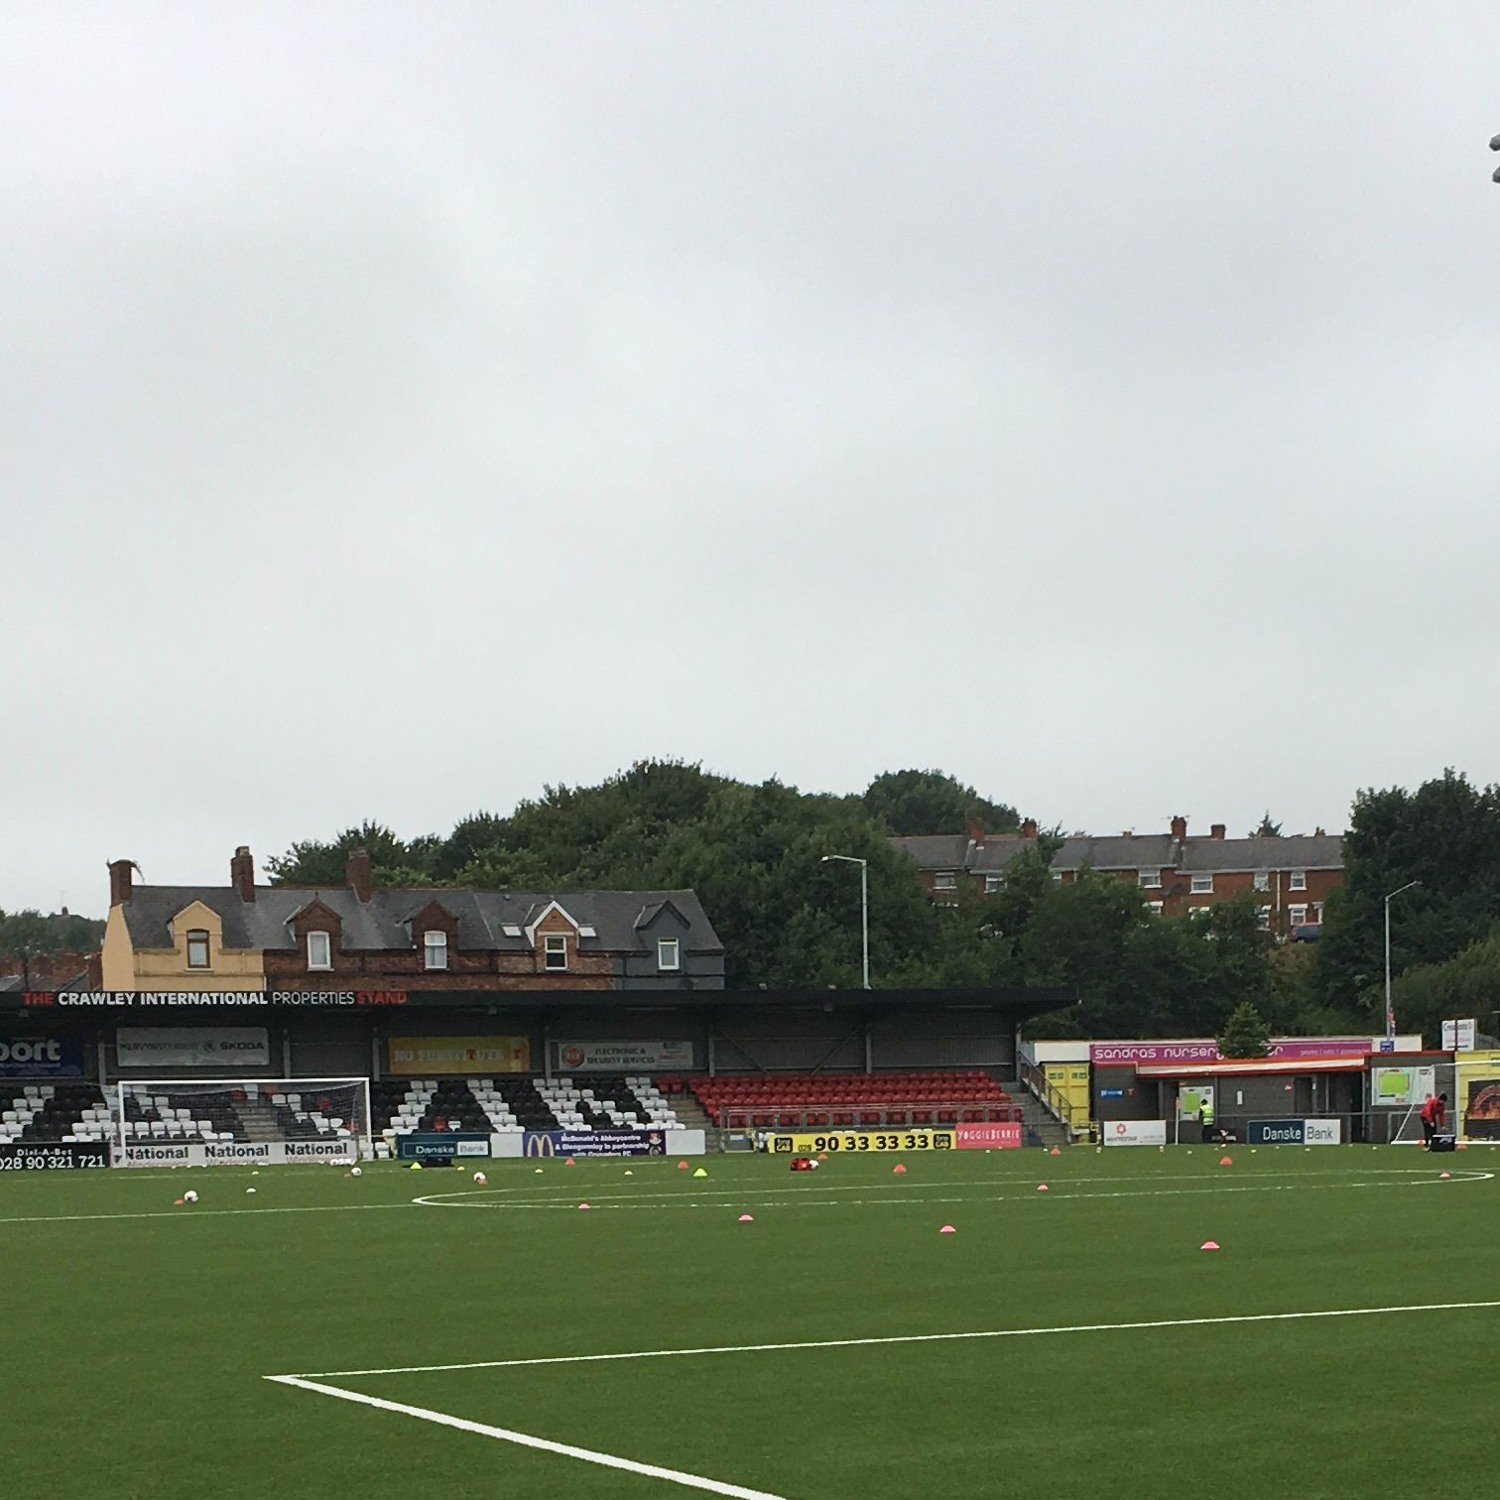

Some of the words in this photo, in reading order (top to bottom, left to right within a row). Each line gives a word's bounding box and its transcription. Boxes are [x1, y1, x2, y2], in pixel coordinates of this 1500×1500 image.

[24, 993, 53, 1004] THE
[58, 992, 135, 1006] CRAWLEY
[140, 991, 268, 1006] INTERNATIONAL
[272, 991, 355, 1005] PROPERTIES
[357, 992, 407, 1004] STAND
[1095, 1048, 1157, 1059] sandras
[1262, 1126, 1301, 1140] Danske
[1308, 1125, 1333, 1140] Bank
[285, 1142, 348, 1156] National
[415, 1145, 455, 1154] Danske
[815, 1136, 839, 1151] 90
[845, 1136, 870, 1150] 33
[876, 1135, 899, 1150] 33
[905, 1135, 929, 1149] 33
[126, 1146, 189, 1160] National
[205, 1145, 269, 1158] National
[27, 1156, 44, 1169] 90
[48, 1156, 75, 1168] 321
[79, 1155, 106, 1168] 721
